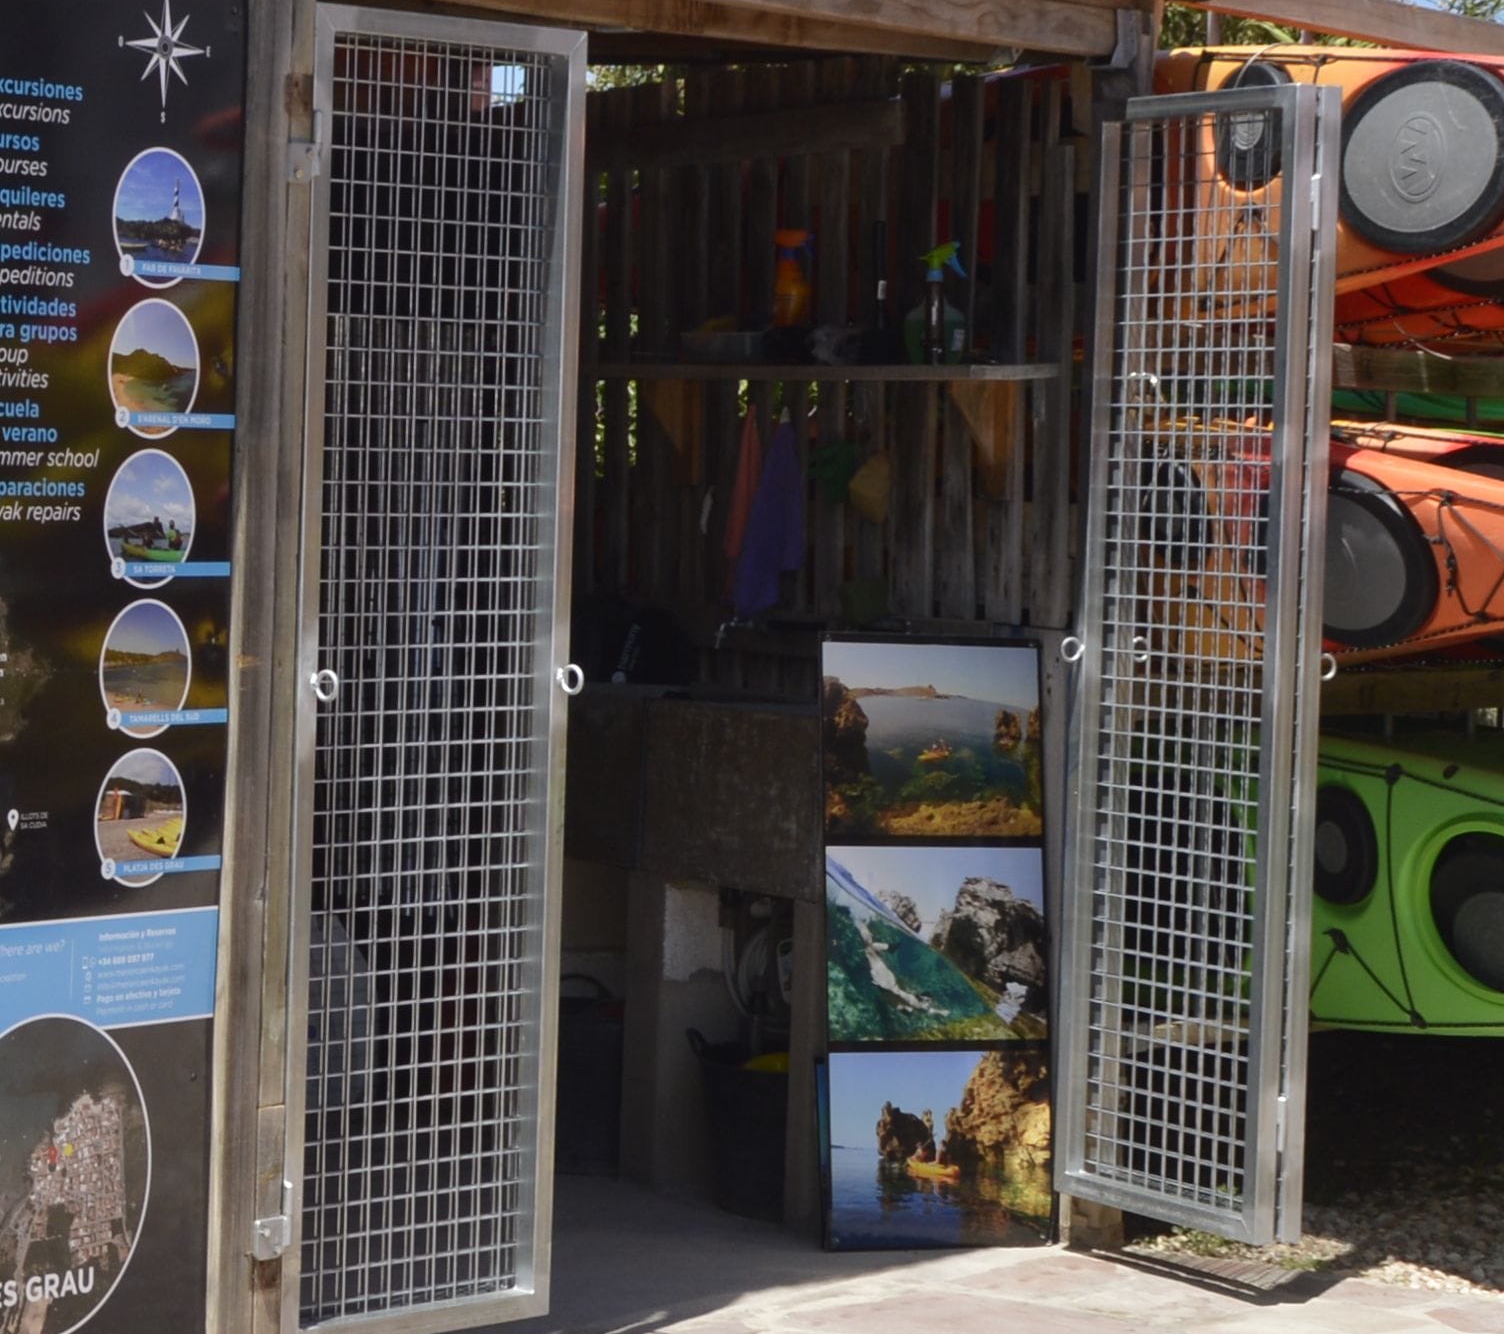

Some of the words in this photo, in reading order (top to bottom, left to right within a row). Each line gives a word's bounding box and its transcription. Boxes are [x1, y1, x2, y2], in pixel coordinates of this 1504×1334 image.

[20, 324, 77, 344] grupos
[2, 426, 58, 443] verano
[47, 448, 100, 468] school
[26, 501, 81, 524] repairs
[25, 943, 43, 955] are
[44, 939, 66, 953] we?
[26, 1266, 95, 1302] GRAU
